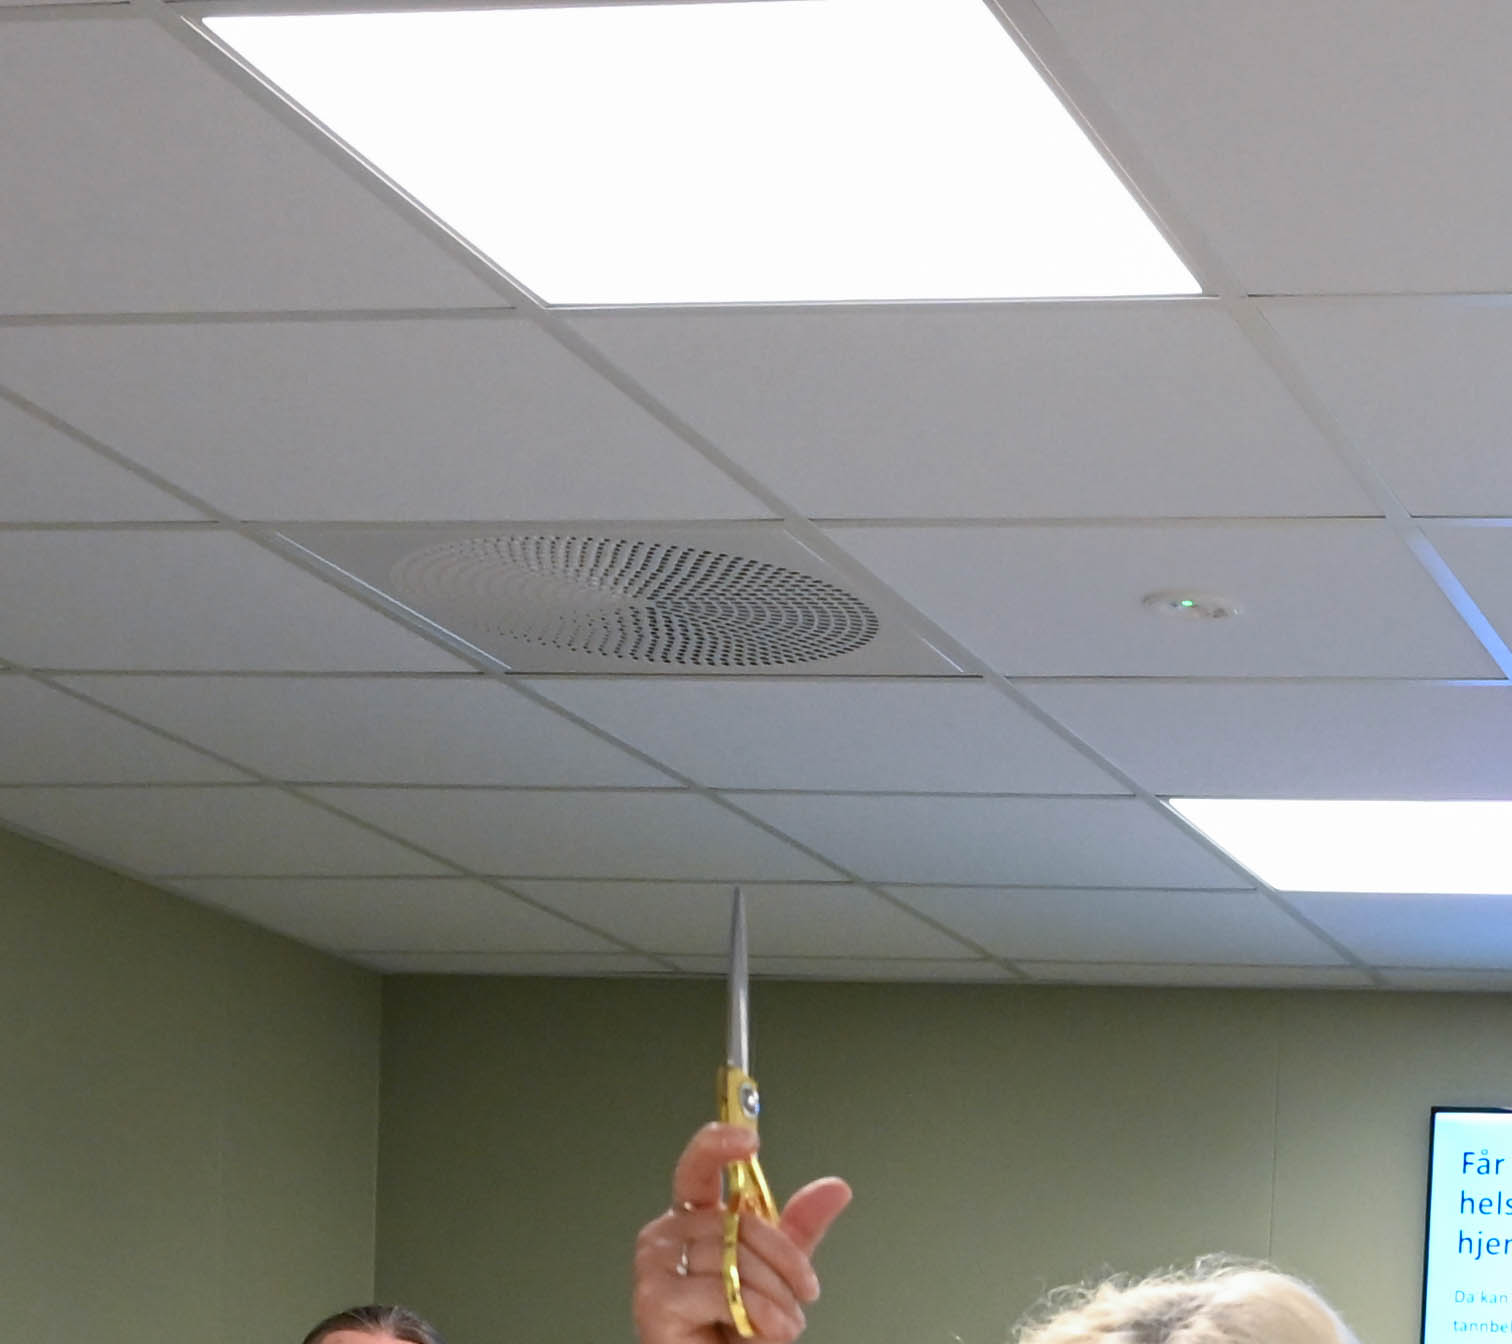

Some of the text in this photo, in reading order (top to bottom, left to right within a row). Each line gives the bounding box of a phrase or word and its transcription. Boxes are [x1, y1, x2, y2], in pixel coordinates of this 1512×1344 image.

[1461, 1148, 1505, 1175] Får
[1454, 1290, 1475, 1304] Da
[1480, 1291, 1508, 1304] kan
